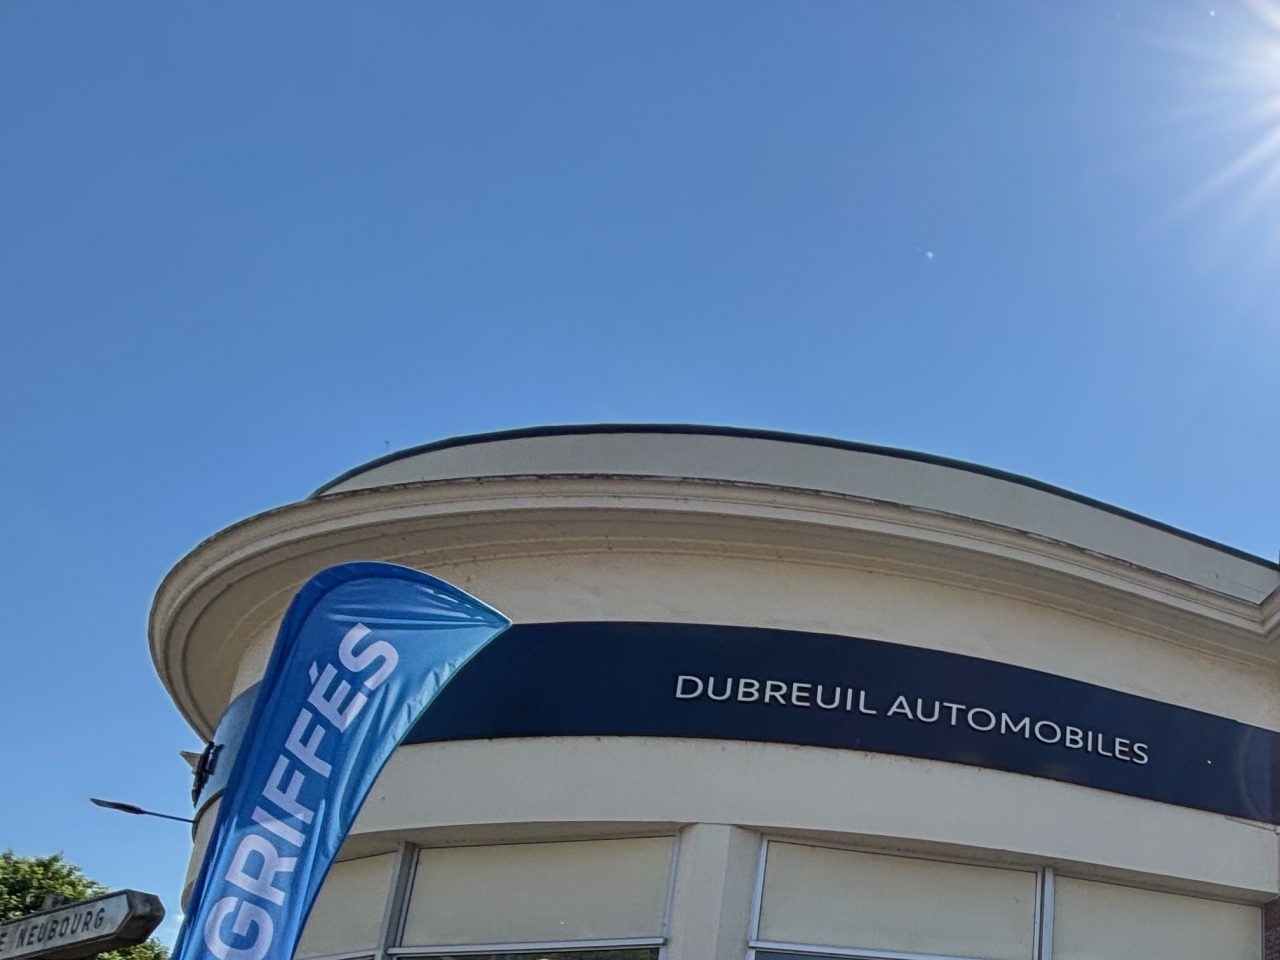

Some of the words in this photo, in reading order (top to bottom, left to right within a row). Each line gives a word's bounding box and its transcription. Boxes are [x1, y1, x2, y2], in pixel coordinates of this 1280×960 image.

[675, 675, 877, 715] DUBREUIL
[887, 695, 1149, 765] AUTOMOBILES
[16, 907, 106, 948] NEUBOURG
